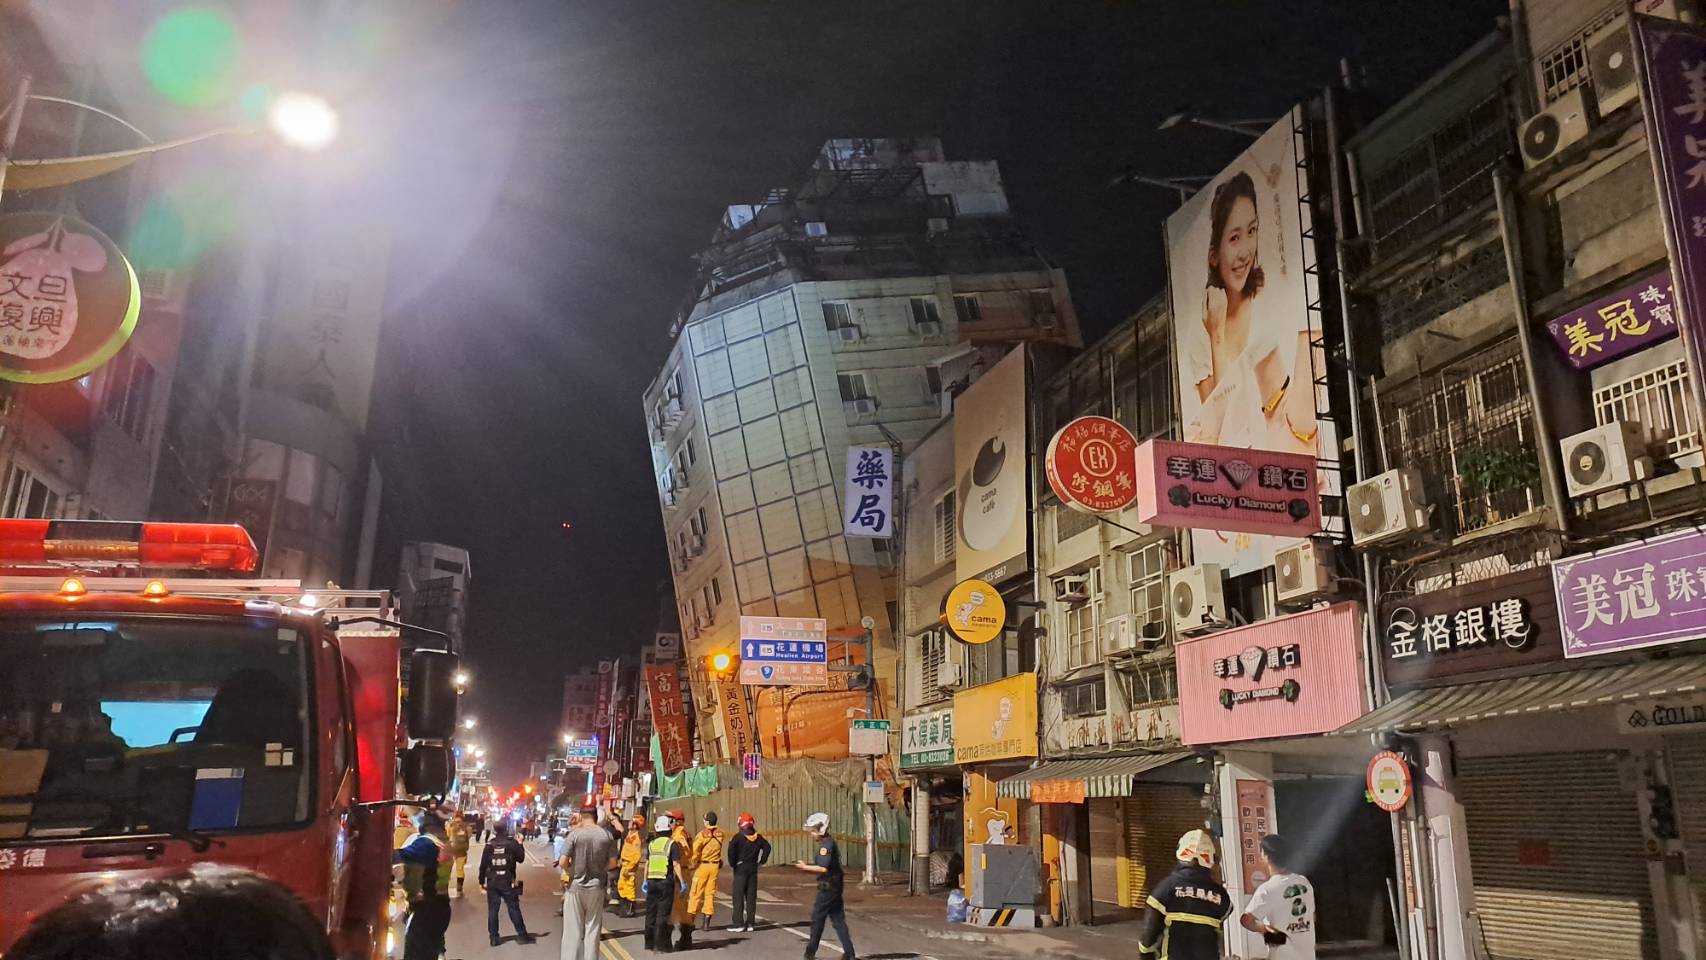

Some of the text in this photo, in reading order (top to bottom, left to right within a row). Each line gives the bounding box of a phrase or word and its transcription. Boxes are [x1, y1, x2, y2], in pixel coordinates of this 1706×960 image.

[0, 271, 67, 303] 文旦
[1565, 299, 1651, 357] 美冠
[1171, 457, 1216, 480] 幸運
[850, 450, 888, 532] 藥局
[1196, 493, 1286, 511] Lucky Diamond
[1571, 562, 1662, 632] 美冠
[971, 616, 997, 624] cama
[1387, 598, 1530, 659] 金格銀樓
[957, 744, 979, 761] cama
